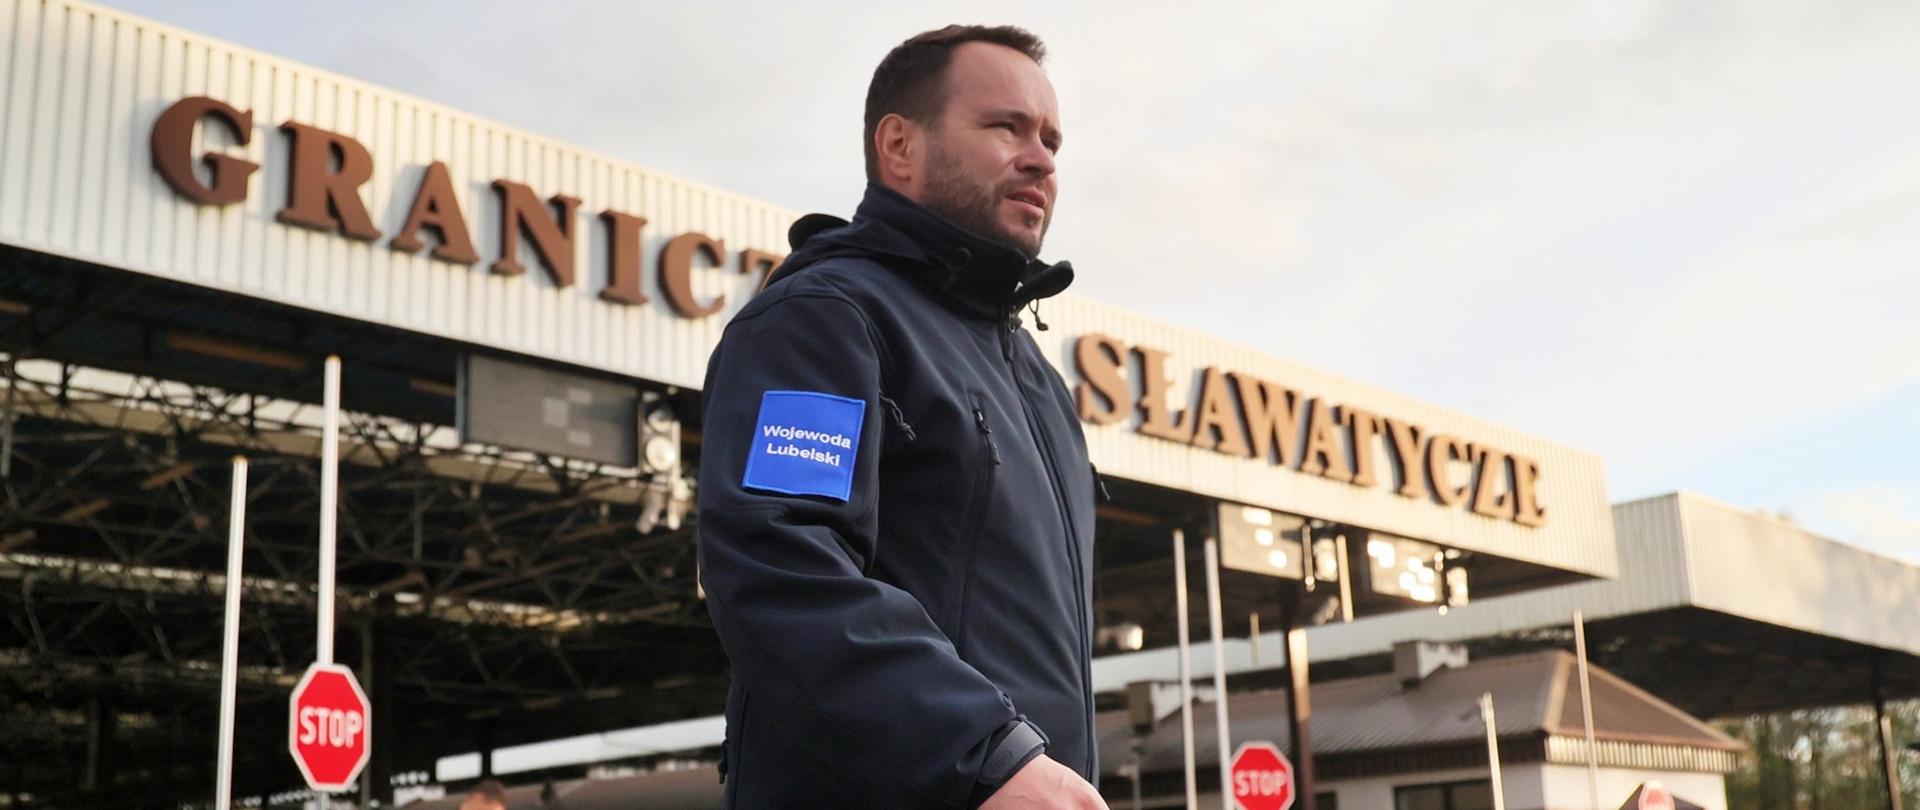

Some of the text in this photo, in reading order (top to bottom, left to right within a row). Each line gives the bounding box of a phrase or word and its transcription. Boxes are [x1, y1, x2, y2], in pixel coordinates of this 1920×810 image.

[763, 425, 851, 449] Wojewoda
[1074, 333, 1546, 527] SŁAWATYCZE
[766, 443, 840, 466] Lubelski
[299, 705, 363, 748] STOP
[1234, 769, 1287, 797] STOP
